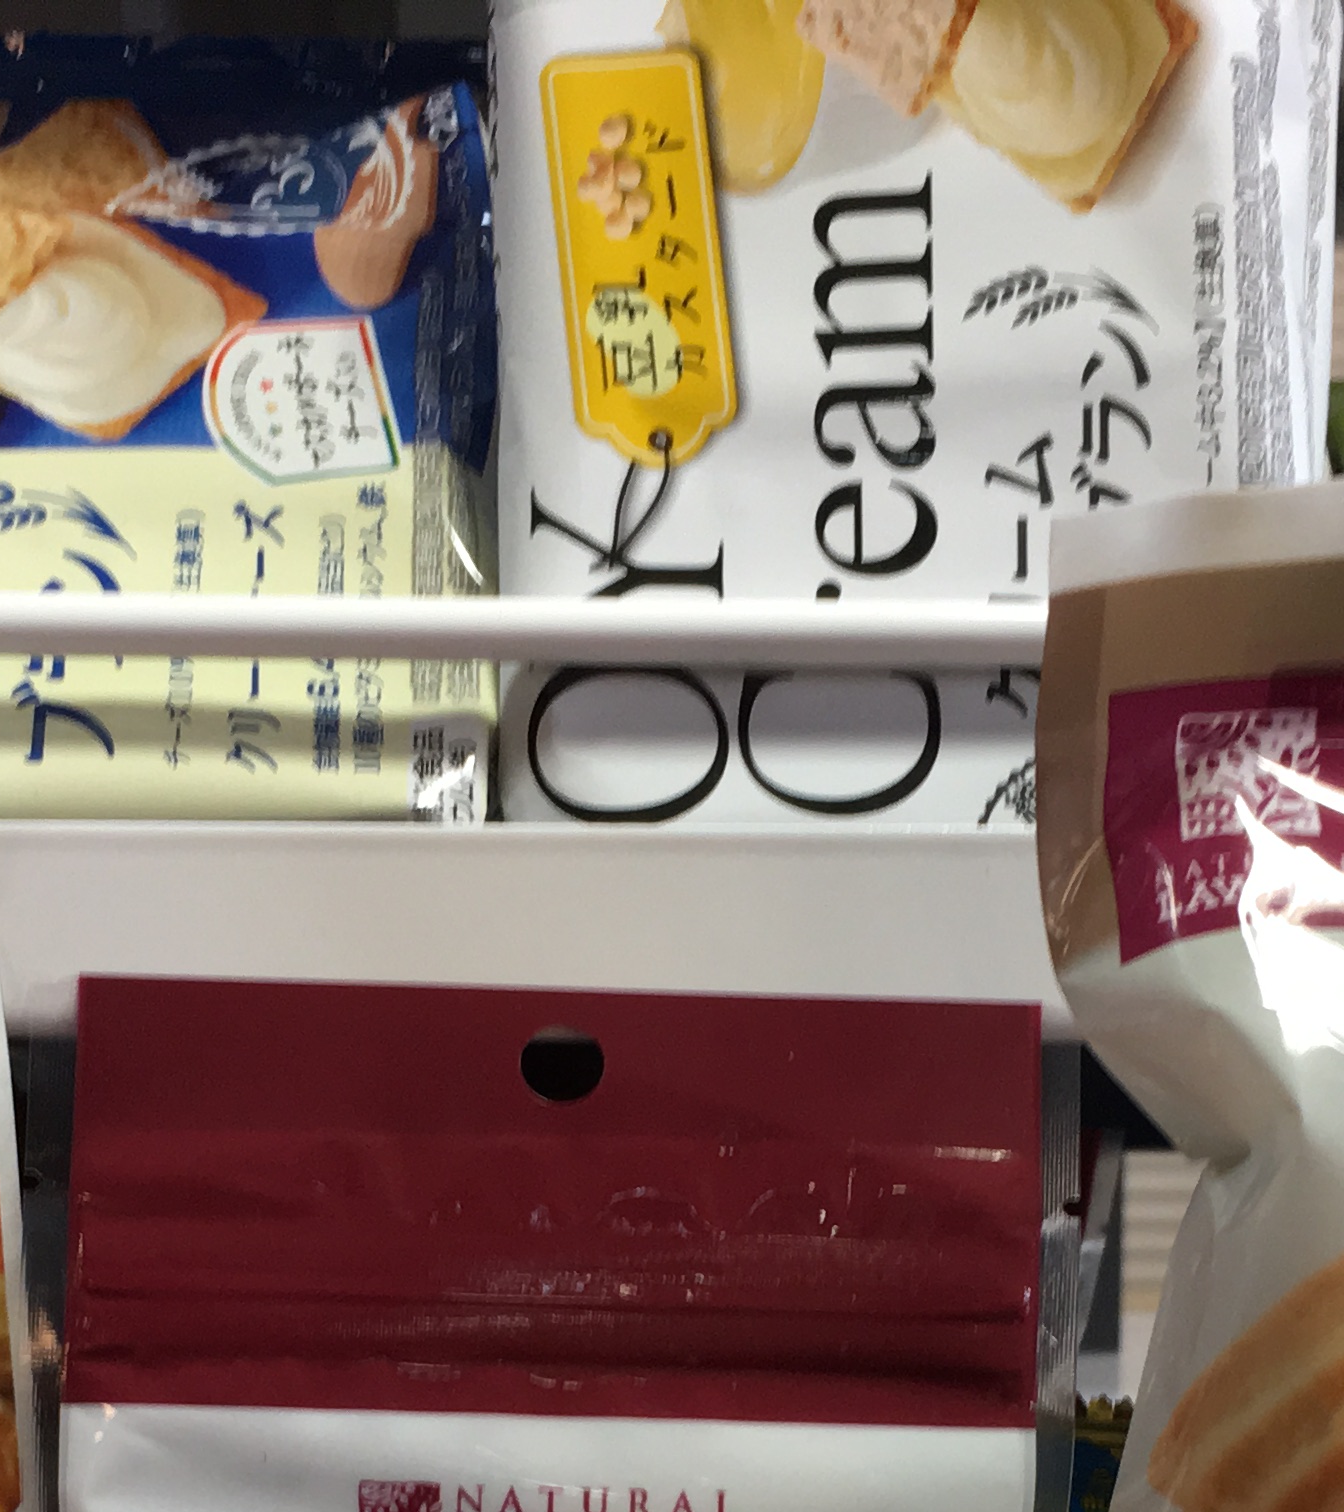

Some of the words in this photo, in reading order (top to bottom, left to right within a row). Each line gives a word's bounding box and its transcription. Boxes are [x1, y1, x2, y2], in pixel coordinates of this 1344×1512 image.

[586, 265, 657, 396] 豆乳
[642, 120, 708, 380] カスタード
[739, 171, 941, 816] Ceam
[227, 499, 285, 774] クリーーズ
